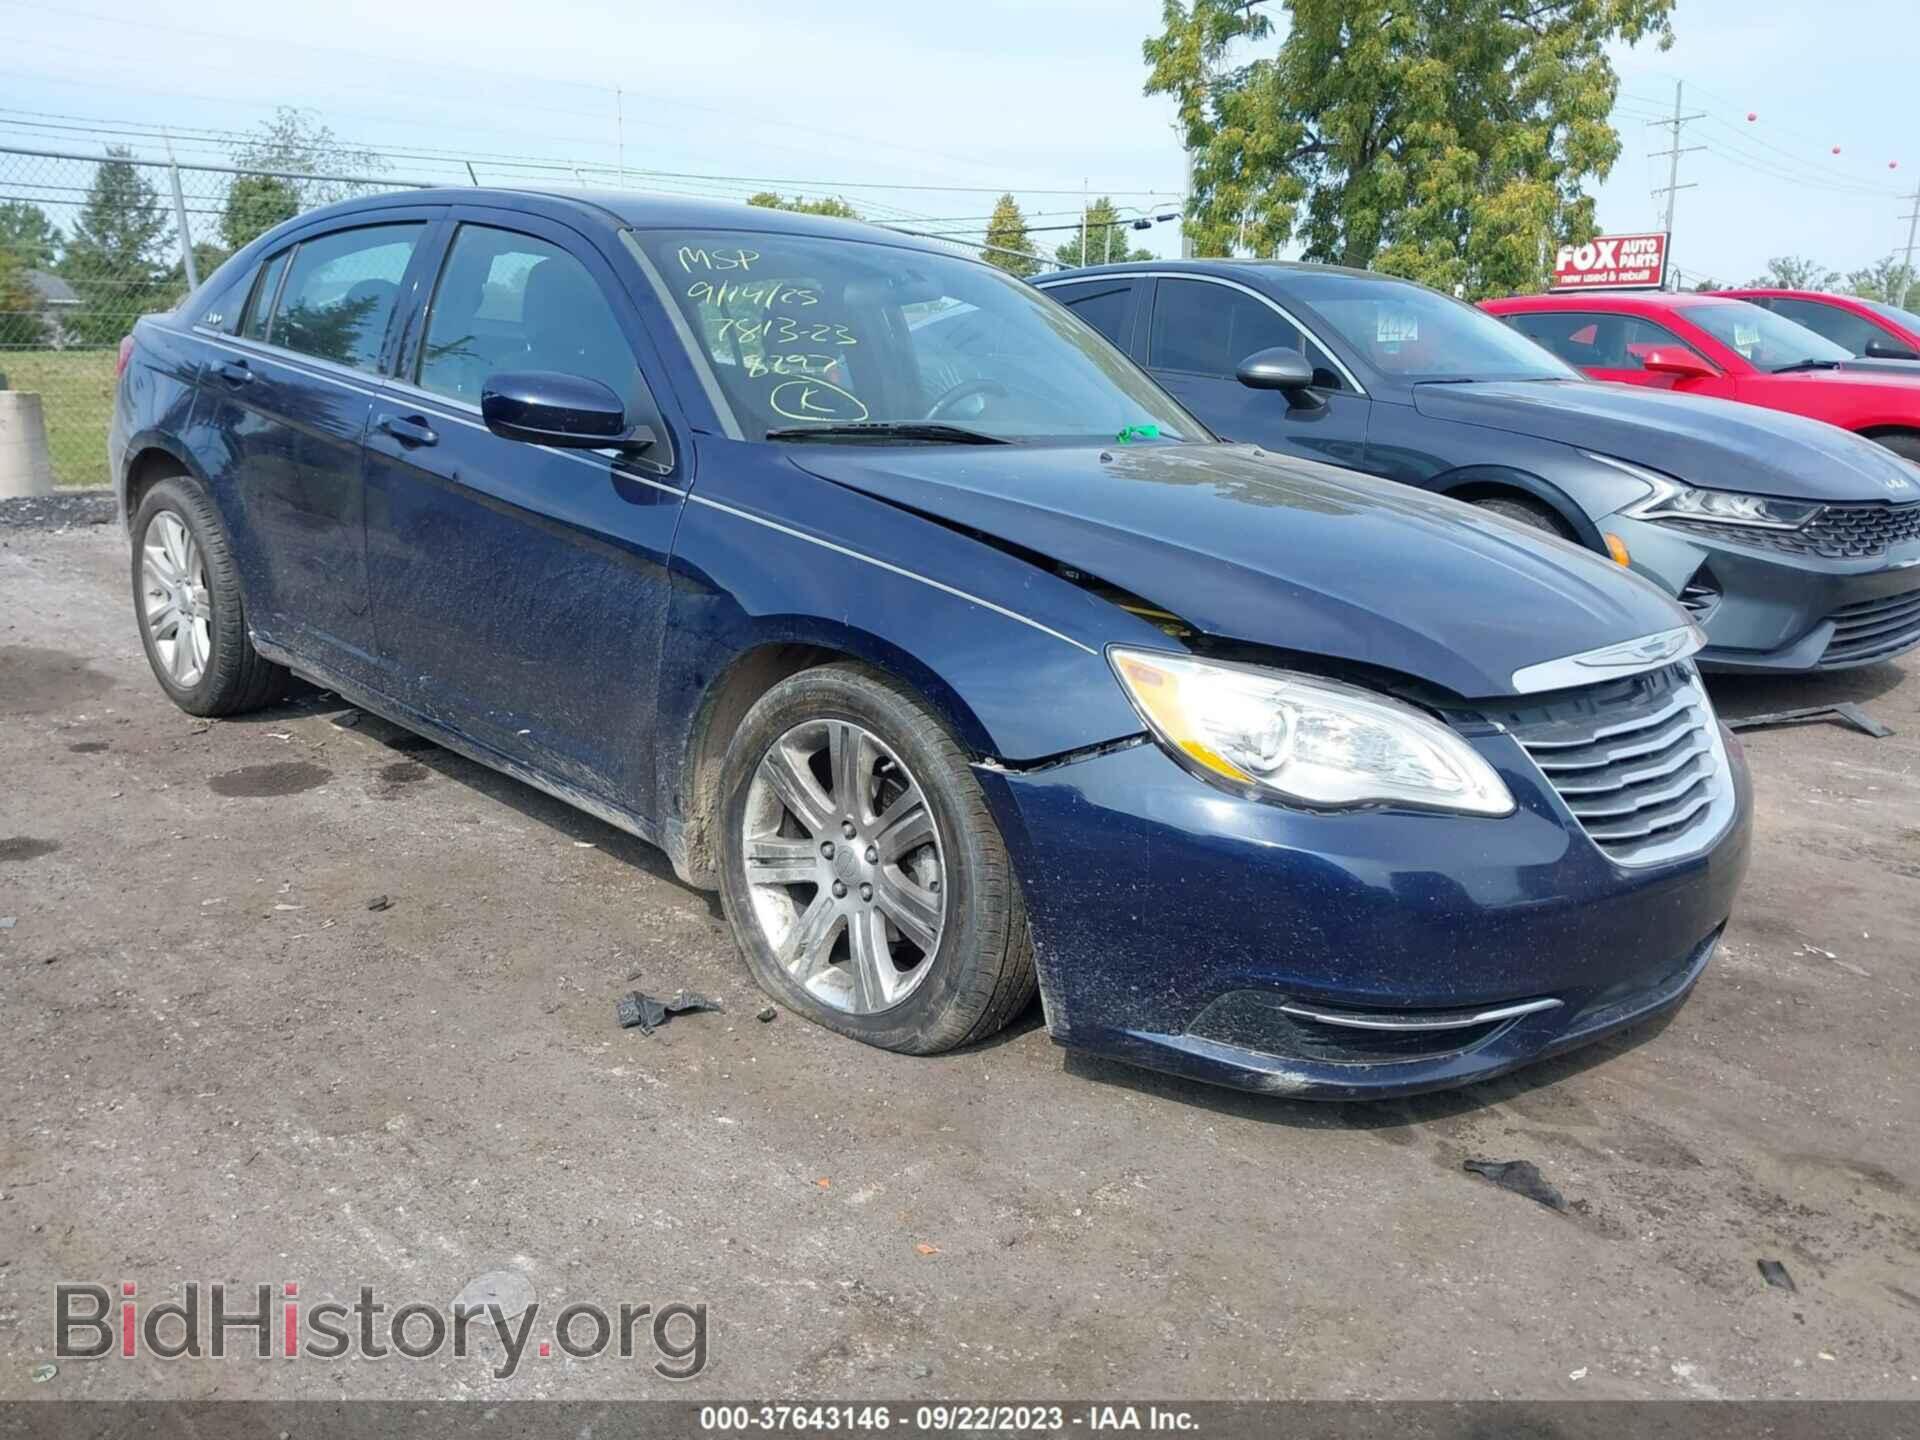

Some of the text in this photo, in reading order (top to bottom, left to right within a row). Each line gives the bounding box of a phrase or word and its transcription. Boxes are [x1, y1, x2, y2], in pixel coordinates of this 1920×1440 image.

[1620, 240, 1657, 254] AUTO
[1556, 240, 1618, 271] FOX
[1619, 253, 1660, 268] PARTS
